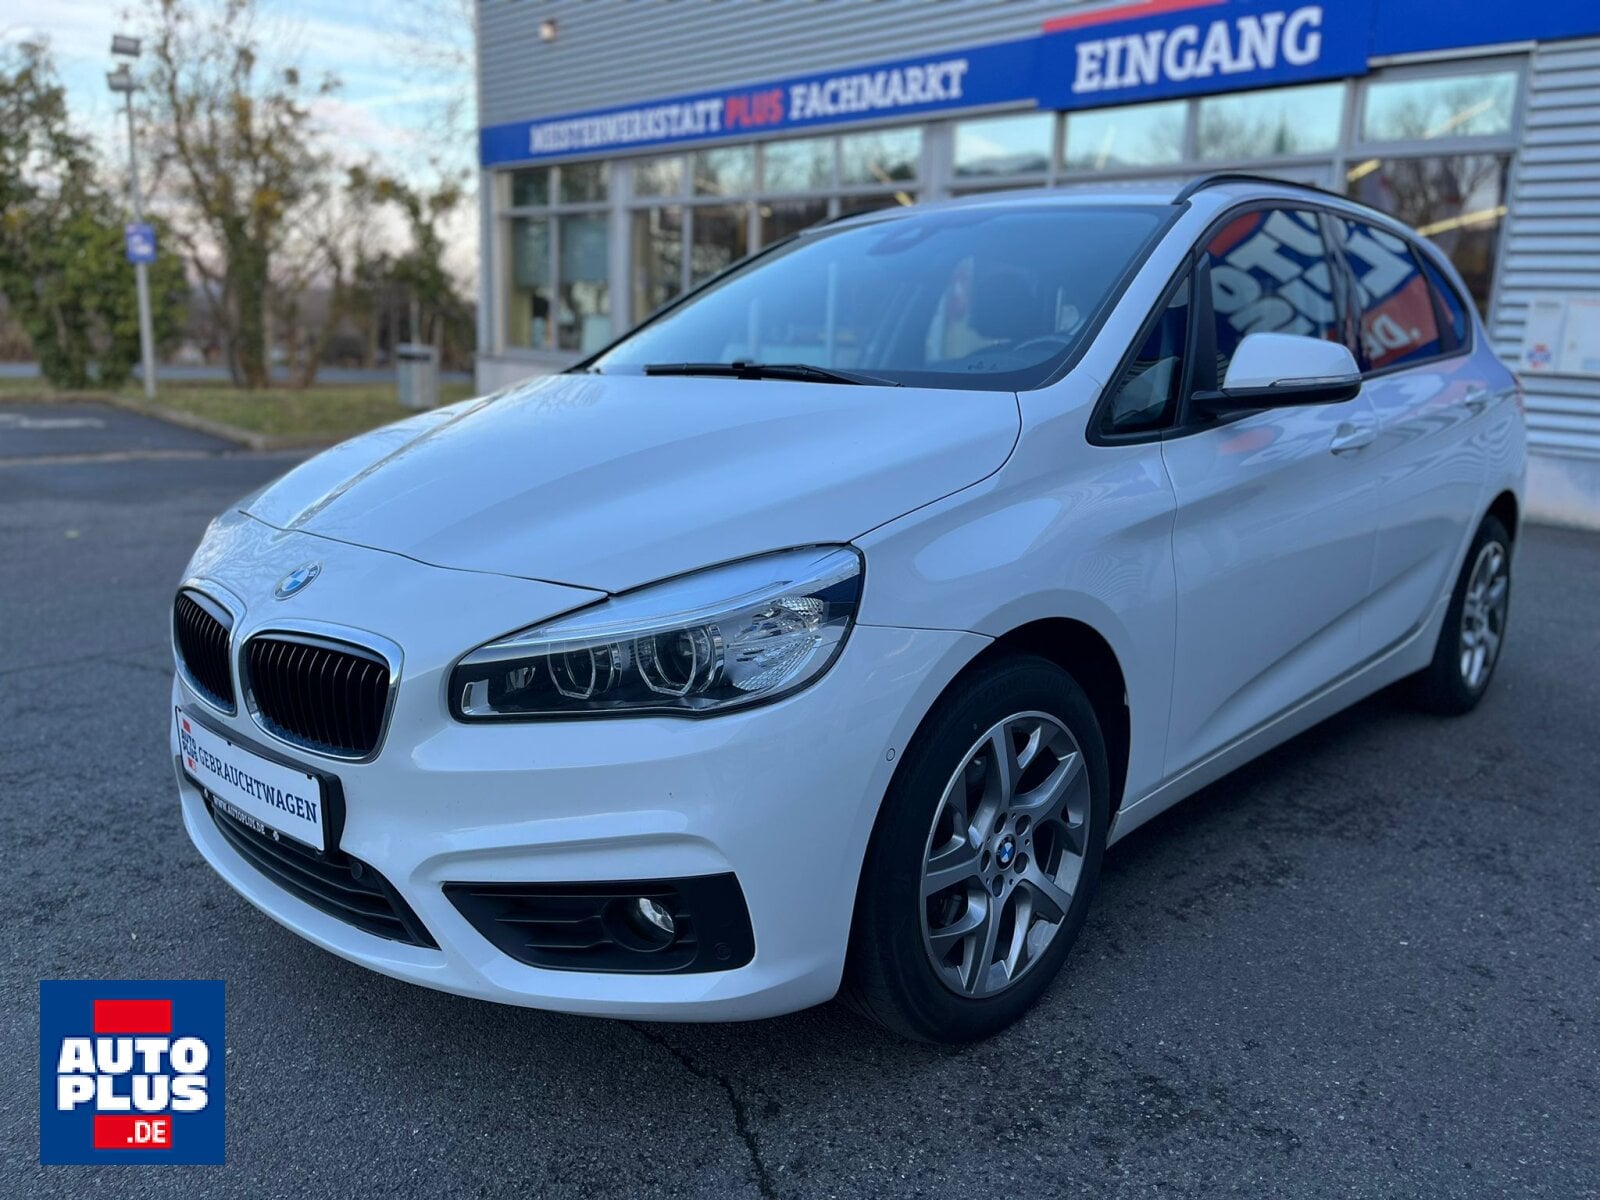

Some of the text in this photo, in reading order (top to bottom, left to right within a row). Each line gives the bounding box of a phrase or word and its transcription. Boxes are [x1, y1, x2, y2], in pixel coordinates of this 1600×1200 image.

[1071, 6, 1323, 93] EINGANG
[528, 58, 969, 154] MEISTERWERKSTATT PLUS FACHMARKT
[198, 746, 318, 824] GEBRAUCHTWAGEN
